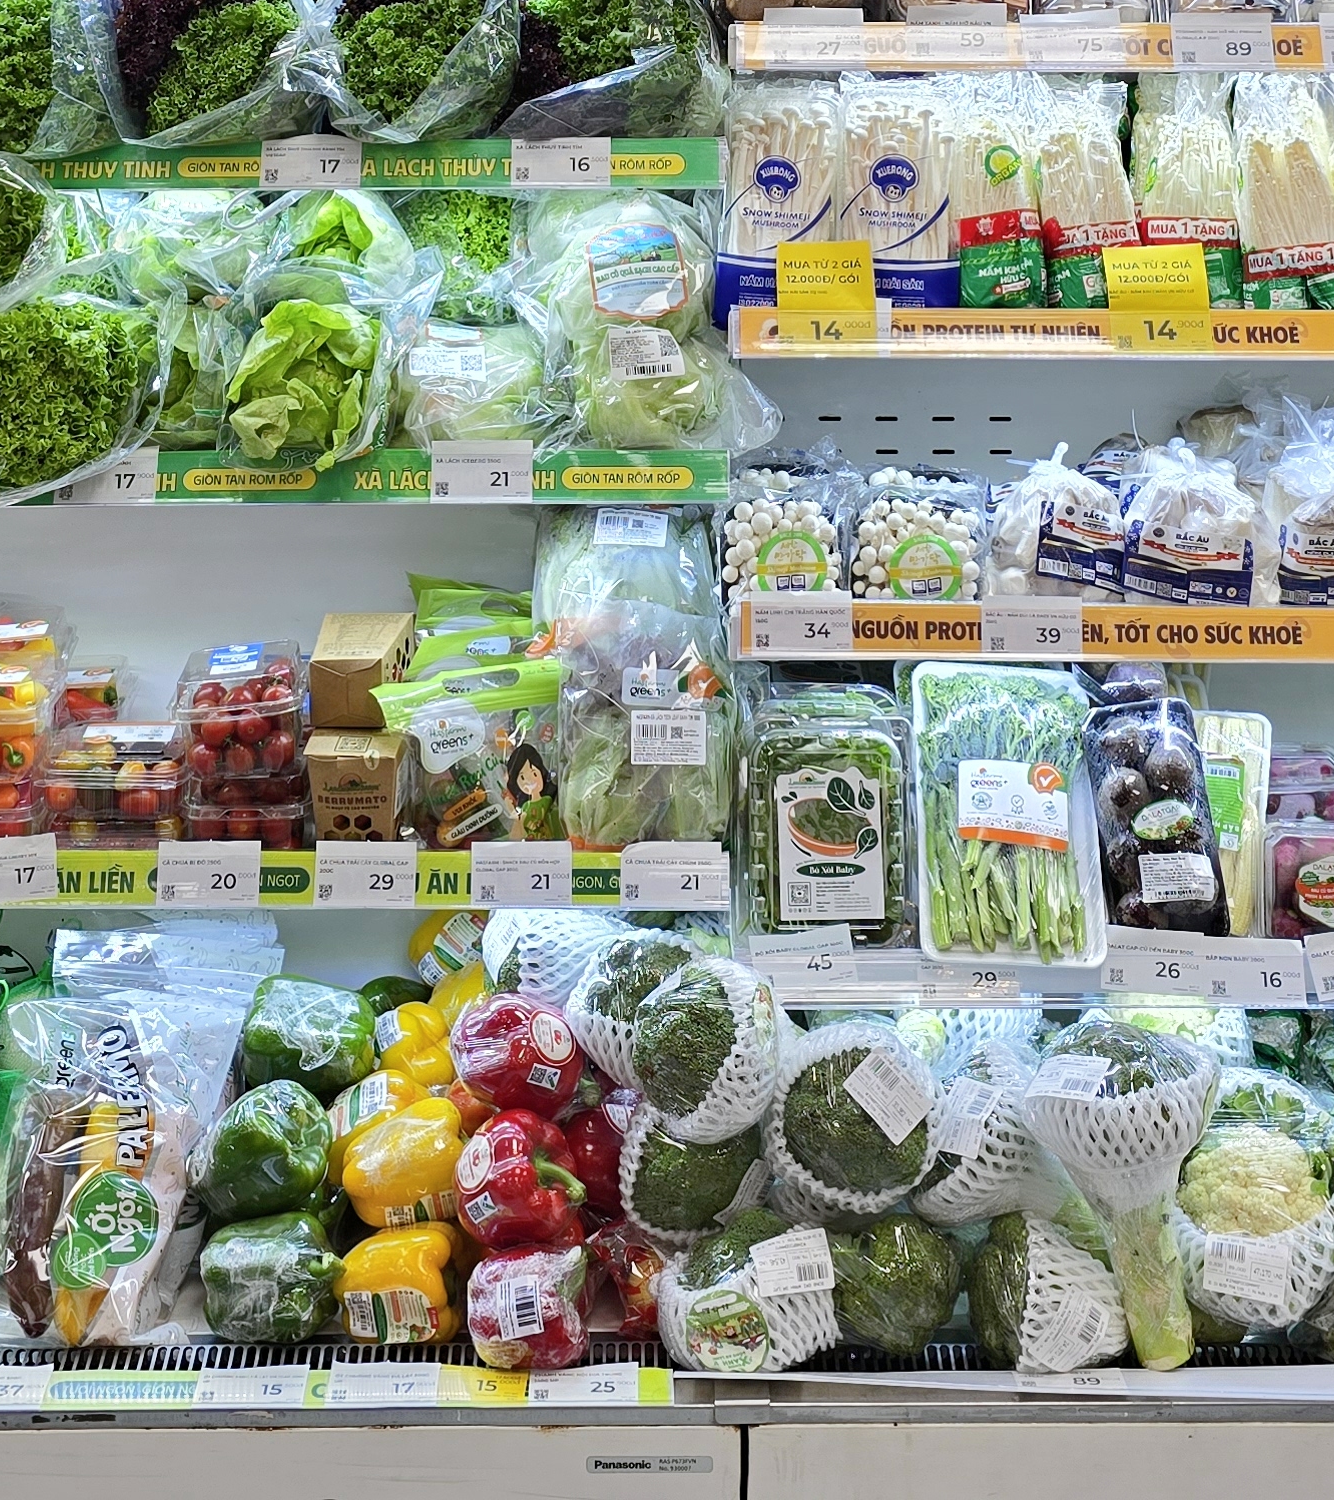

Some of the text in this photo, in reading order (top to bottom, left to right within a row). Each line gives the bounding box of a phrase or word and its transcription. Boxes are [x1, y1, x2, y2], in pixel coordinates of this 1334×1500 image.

[320, 160, 340, 173] 17
[382, 153, 496, 177] LÁCH THỦY
[742, 206, 810, 222] SNOW SHIMEJI
[752, 219, 799, 230] MUSHROOM
[1150, 222, 1177, 236] MUA
[1180, 218, 1190, 237] 1
[1193, 217, 1226, 238] TẶNG
[783, 255, 863, 271] MUA TỪ 2 GIÁ
[838, 270, 860, 286] GÓI
[811, 321, 842, 340] 14
[491, 472, 508, 486] 21
[1037, 628, 1060, 643] 39
[318, 795, 387, 805] BERRUMATO
[15, 867, 35, 884] 17
[211, 874, 236, 889] 20
[267, 873, 301, 890] NGỌT
[1156, 962, 1180, 978] 26
[262, 1383, 284, 1396] 15
[594, 1458, 652, 1471] Panasonic
